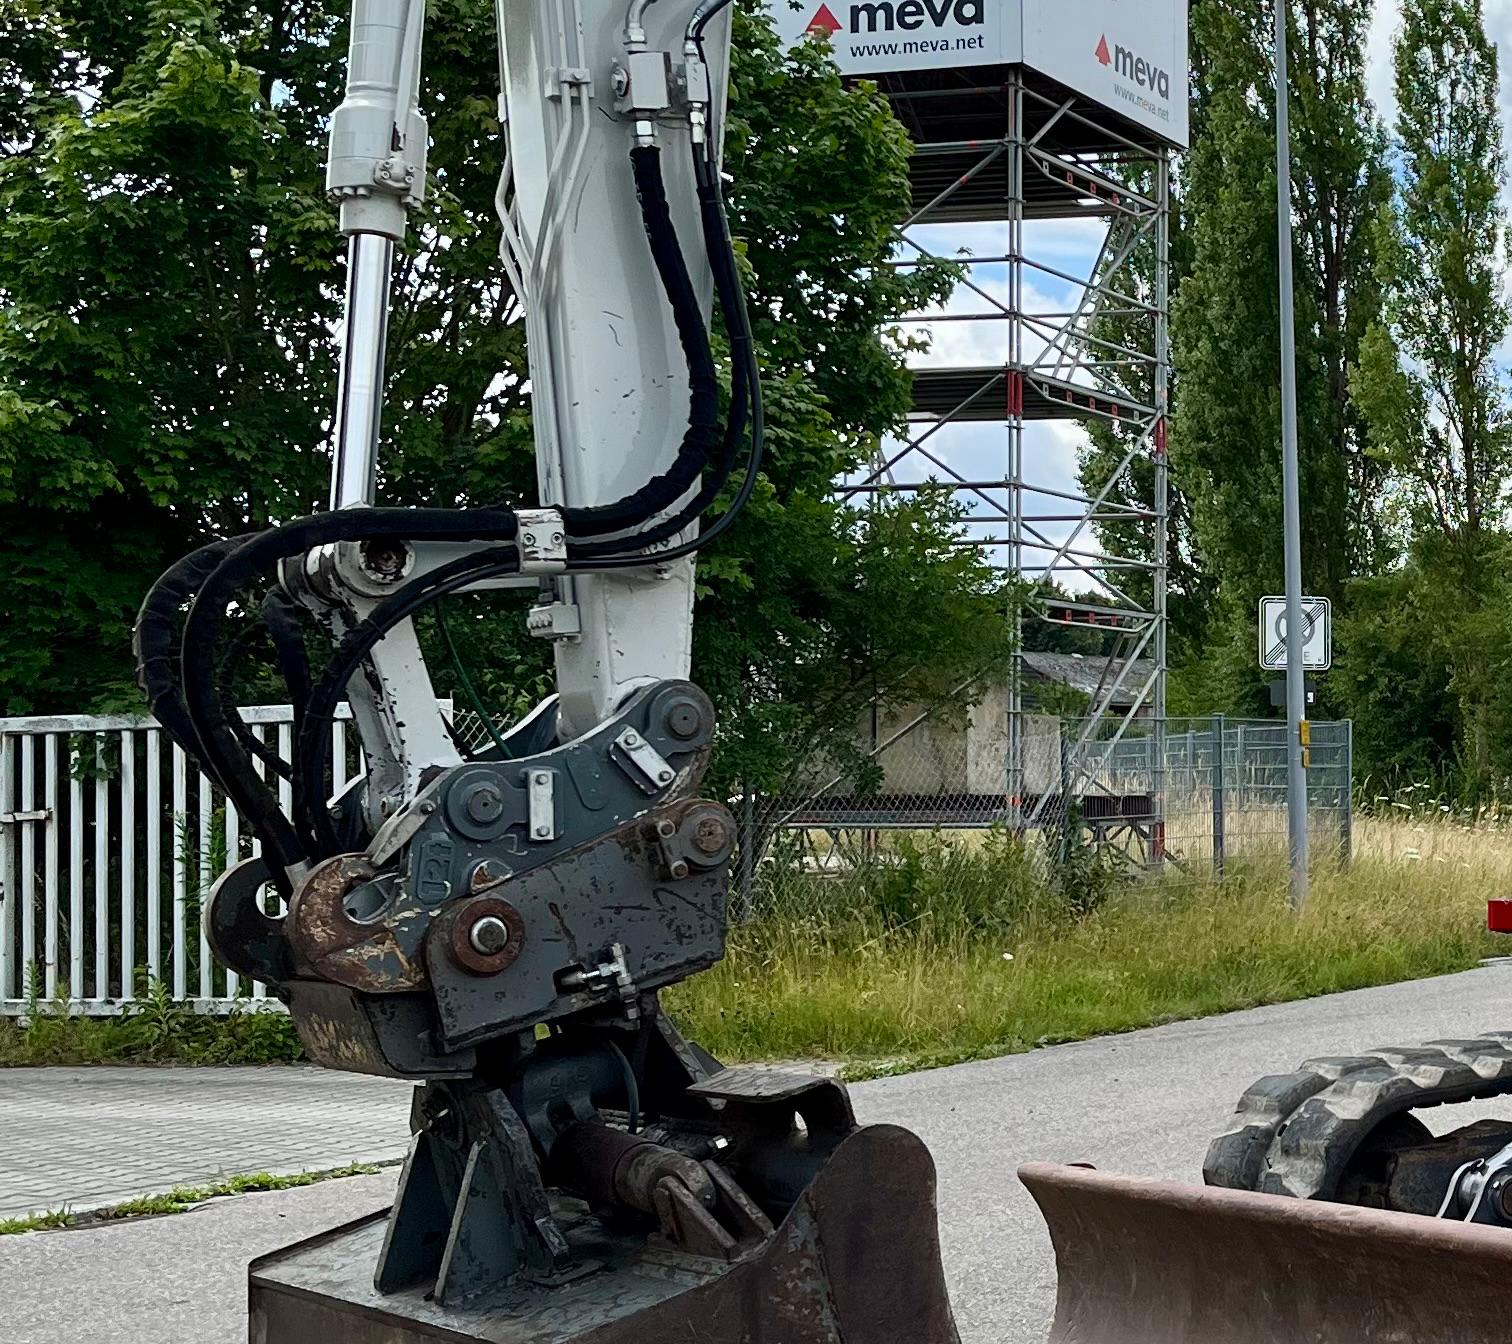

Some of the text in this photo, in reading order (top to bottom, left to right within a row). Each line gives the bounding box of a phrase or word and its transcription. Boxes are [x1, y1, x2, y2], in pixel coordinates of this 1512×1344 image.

[850, 34, 985, 57] www.meva.net
[1115, 44, 1169, 100] meva
[1114, 83, 1169, 122] www.meva.net
